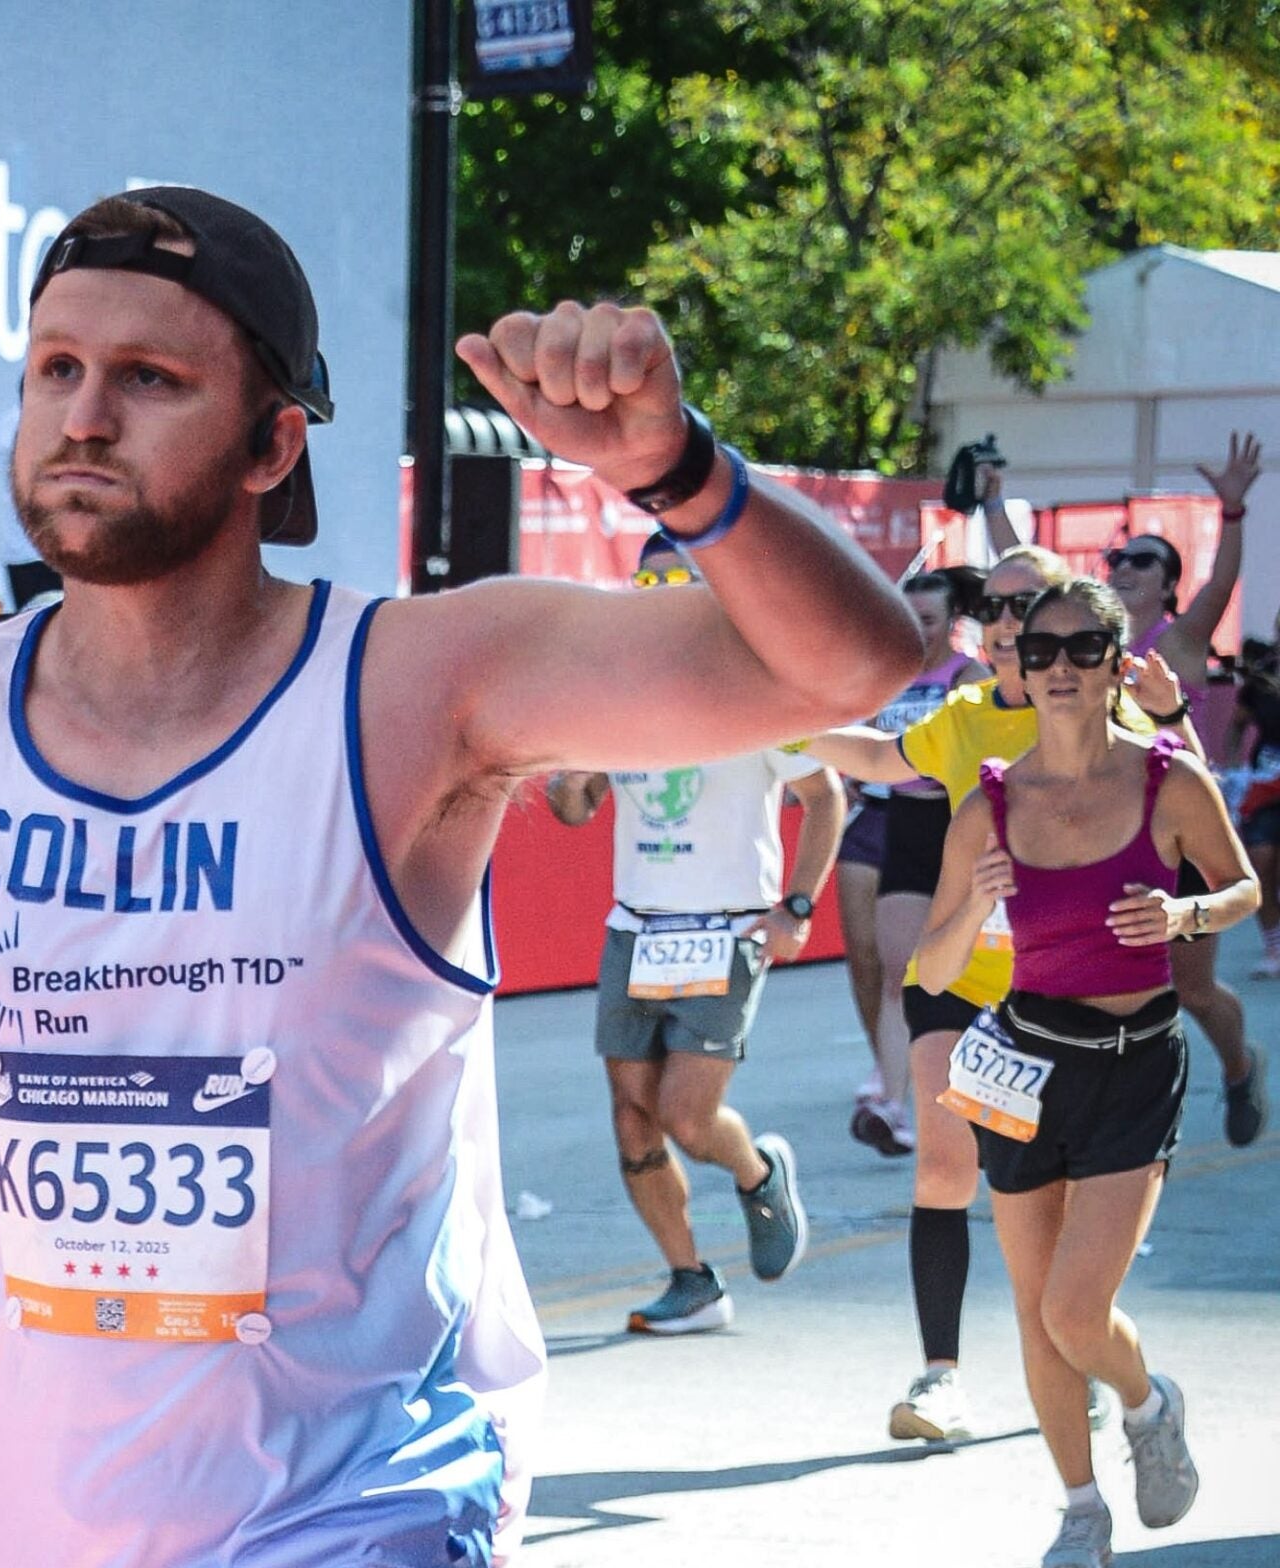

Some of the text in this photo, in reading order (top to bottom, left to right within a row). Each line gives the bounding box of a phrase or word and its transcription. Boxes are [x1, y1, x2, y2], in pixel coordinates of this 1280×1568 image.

[12, 960, 224, 993] Breakthrough
[35, 1010, 88, 1035] Run
[18, 1074, 127, 1087] BANK OF AMERICA
[18, 1089, 169, 1107] CHICAGO MARATHON
[54, 1237, 170, 1254] October 12, 2025
